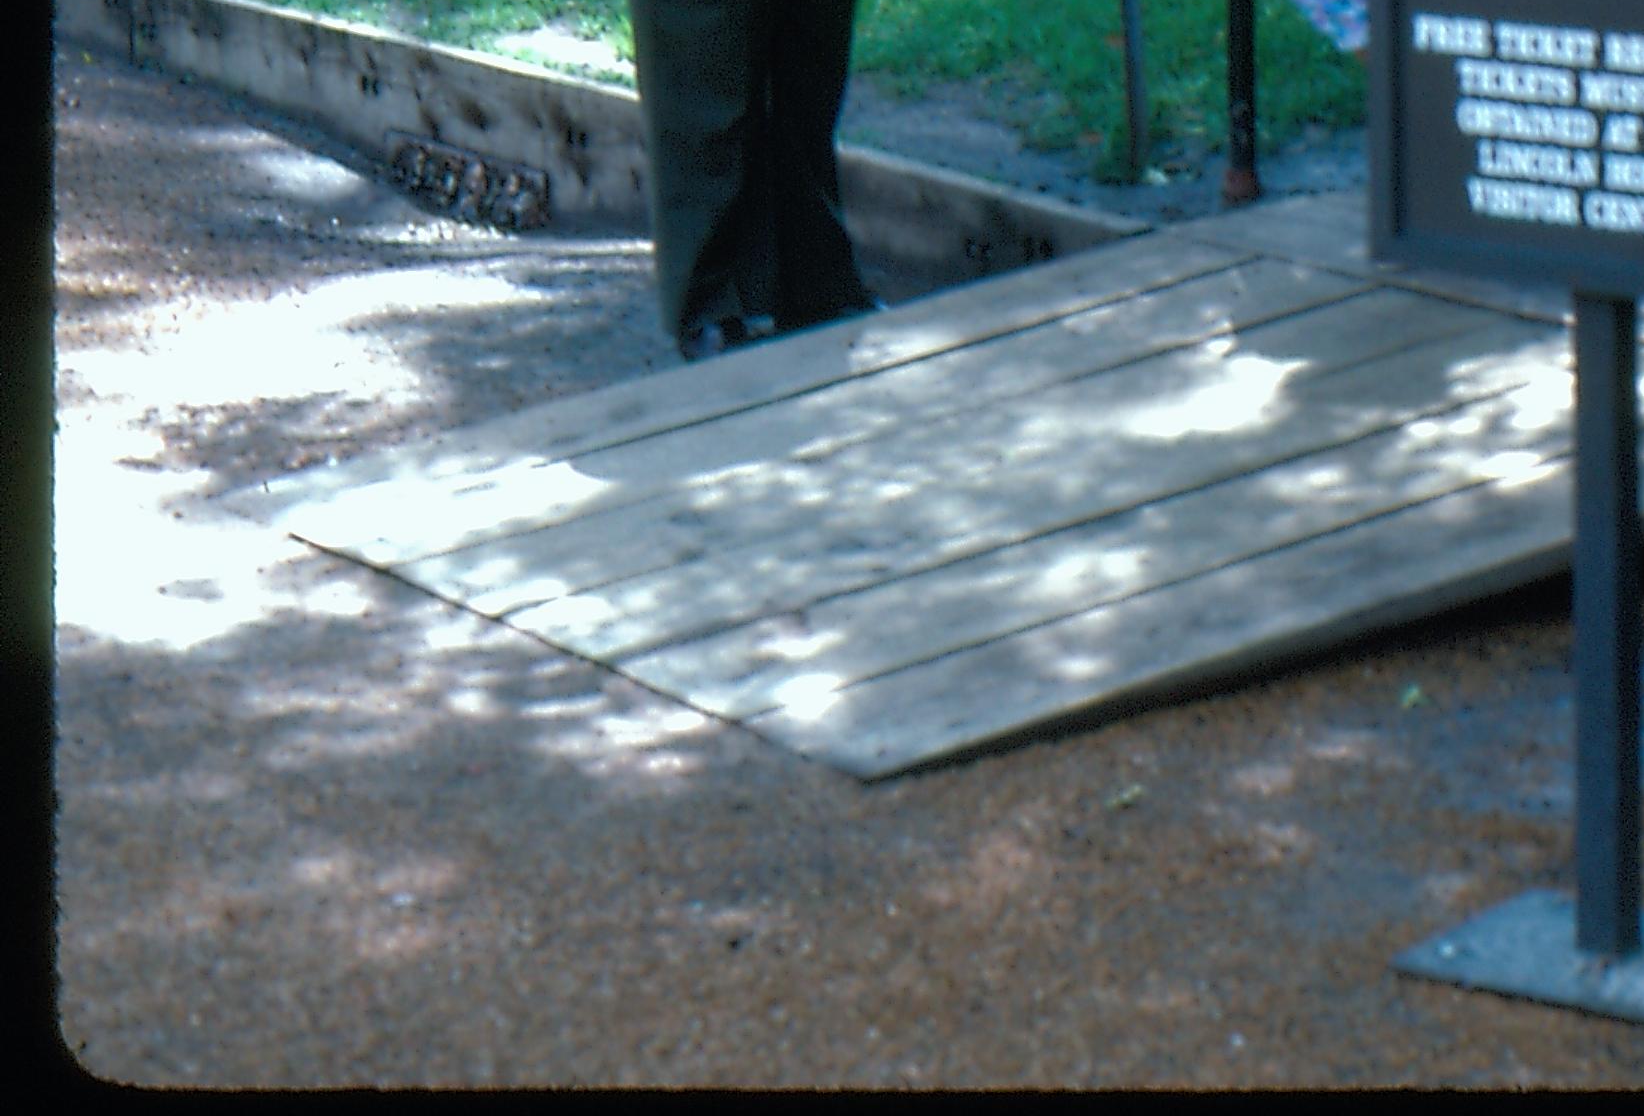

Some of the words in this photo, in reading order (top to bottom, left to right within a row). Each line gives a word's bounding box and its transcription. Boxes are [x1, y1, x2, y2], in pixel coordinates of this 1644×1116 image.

[1602, 114, 1642, 152] AT
[1476, 139, 1599, 186] LINCOLN
[1468, 177, 1580, 225] VISITOR
